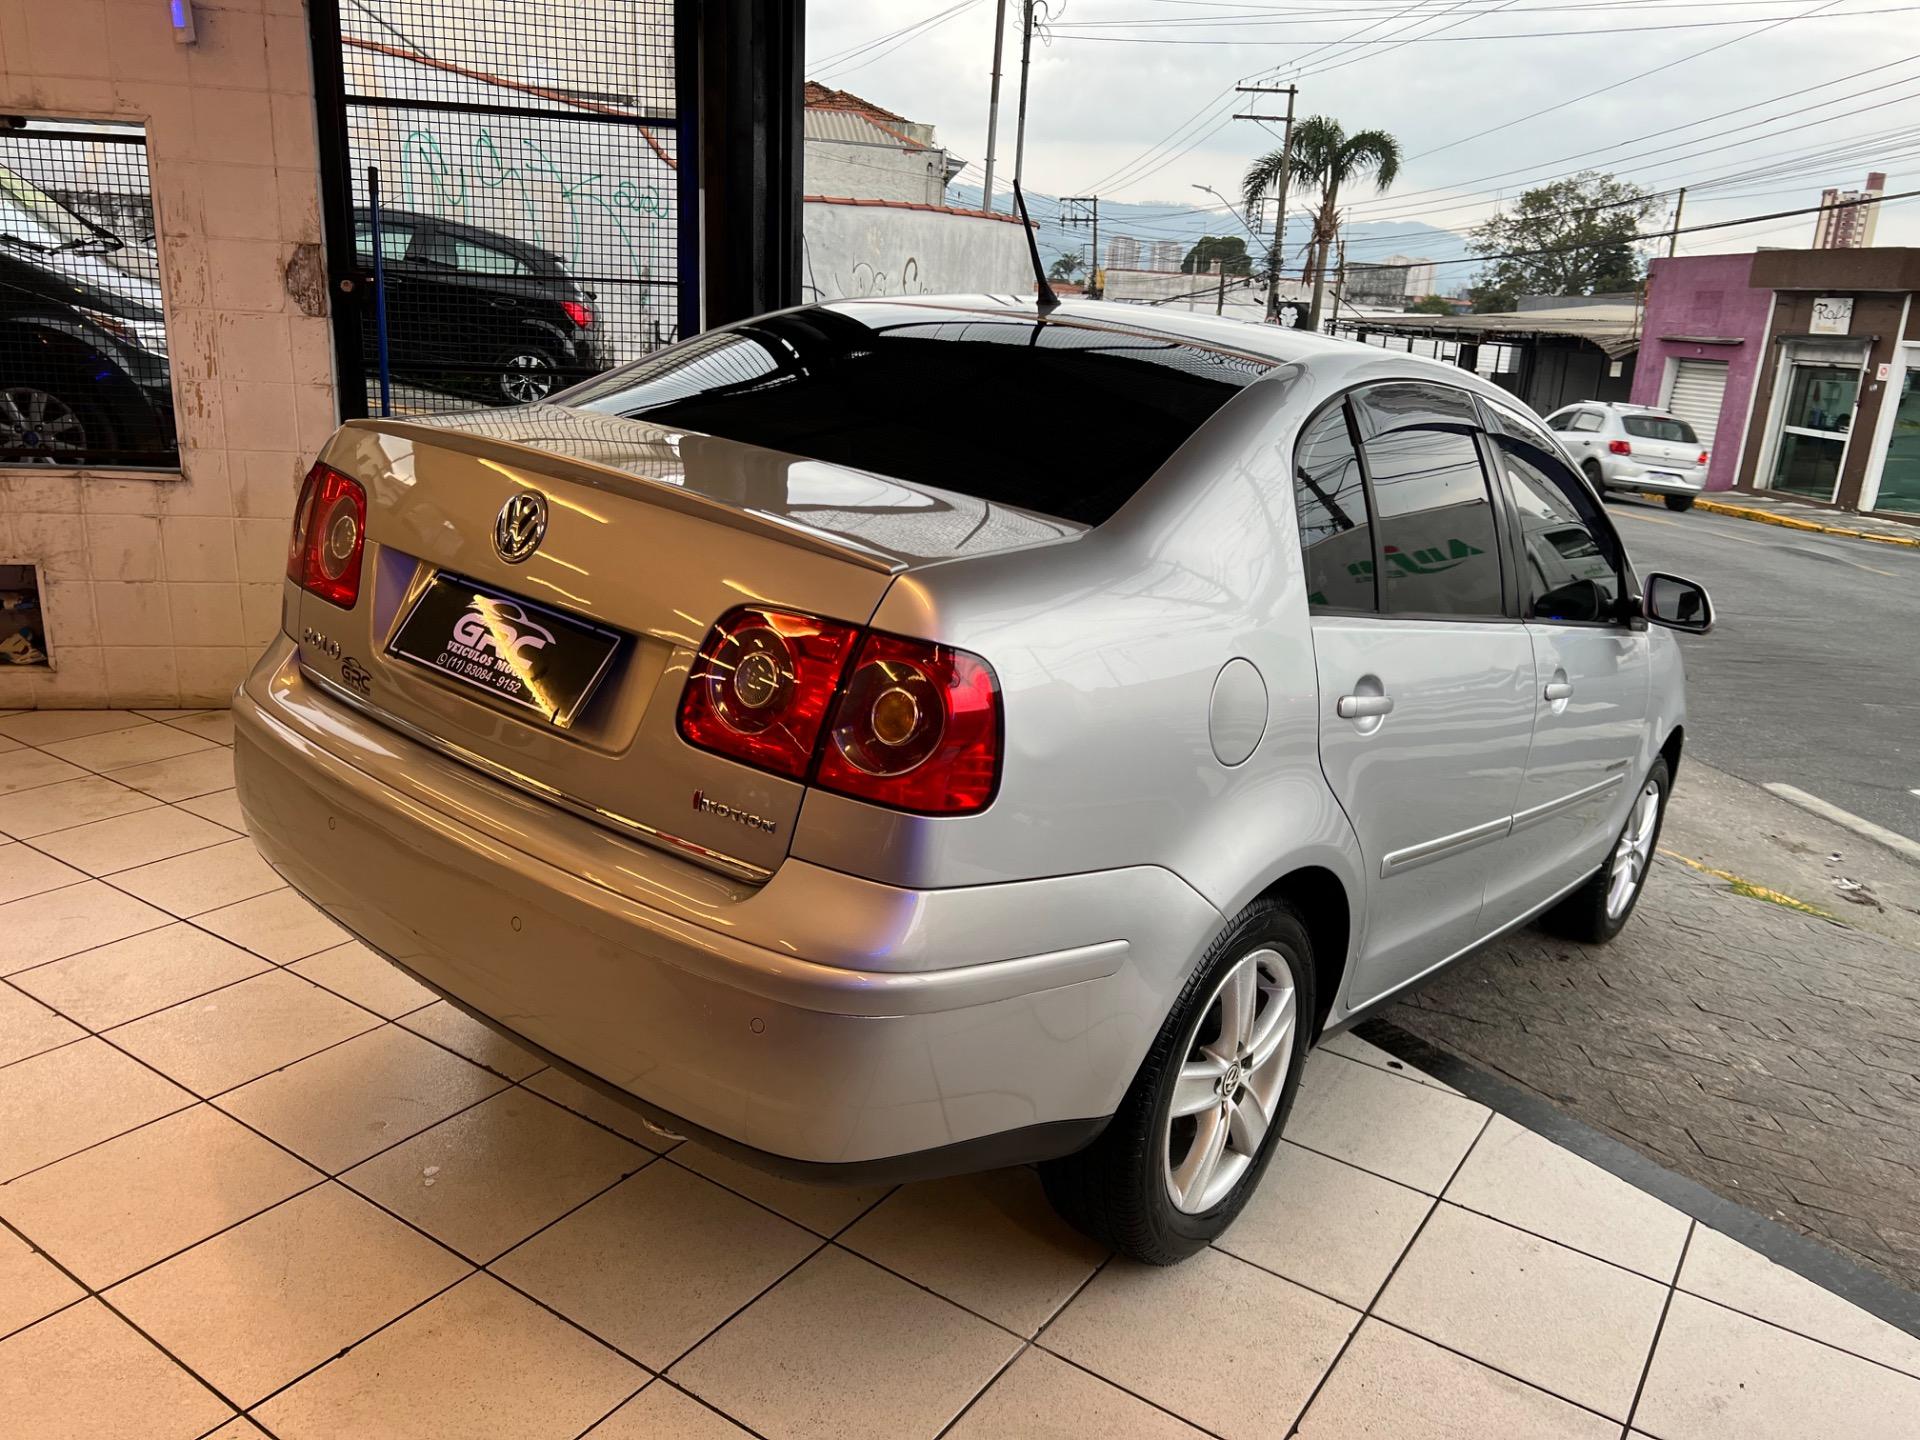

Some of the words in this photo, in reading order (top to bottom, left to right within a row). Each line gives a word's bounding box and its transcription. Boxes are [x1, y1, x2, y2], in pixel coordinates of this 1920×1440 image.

[446, 640, 494, 667] VEICULOS
[453, 612, 546, 671] GRC
[446, 653, 465, 673] (11)
[341, 664, 371, 692] GRC
